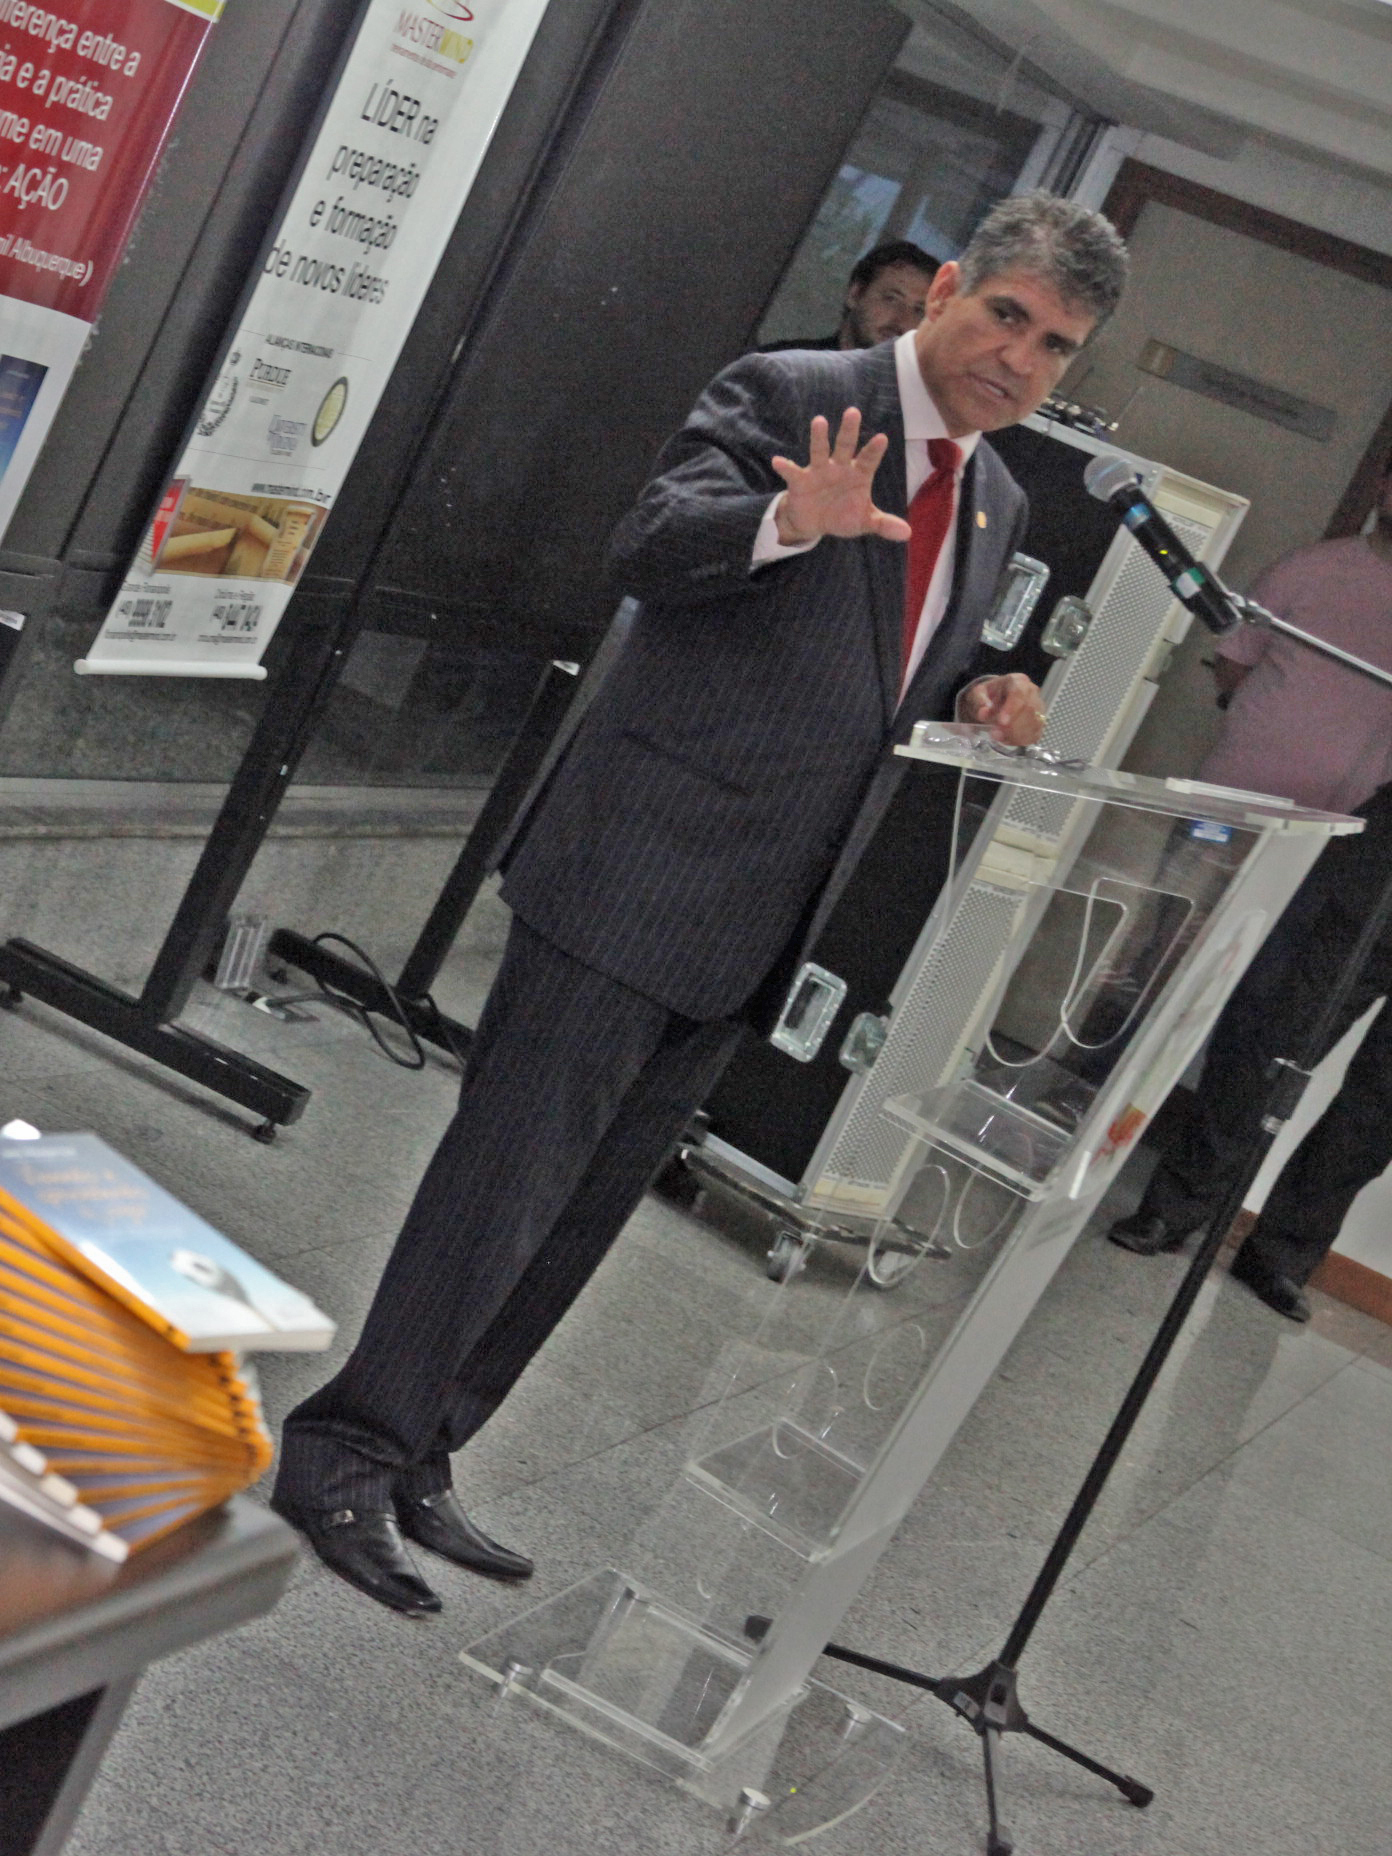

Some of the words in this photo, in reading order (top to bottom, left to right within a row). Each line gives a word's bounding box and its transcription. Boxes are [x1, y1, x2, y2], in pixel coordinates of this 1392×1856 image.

[76, 30, 127, 71] entre
[123, 51, 142, 77] a
[16, 62, 34, 88] e
[32, 69, 51, 96] a
[44, 75, 113, 121] prática
[360, 79, 421, 138] LÍDER
[414, 114, 439, 145] na
[28, 123, 63, 158] em
[61, 135, 104, 171] uma
[326, 144, 420, 202] preparação
[3, 163, 69, 211] AÇÃO
[310, 198, 325, 227] e
[324, 196, 398, 255] formação
[263, 239, 292, 277] de
[289, 254, 346, 294] novos
